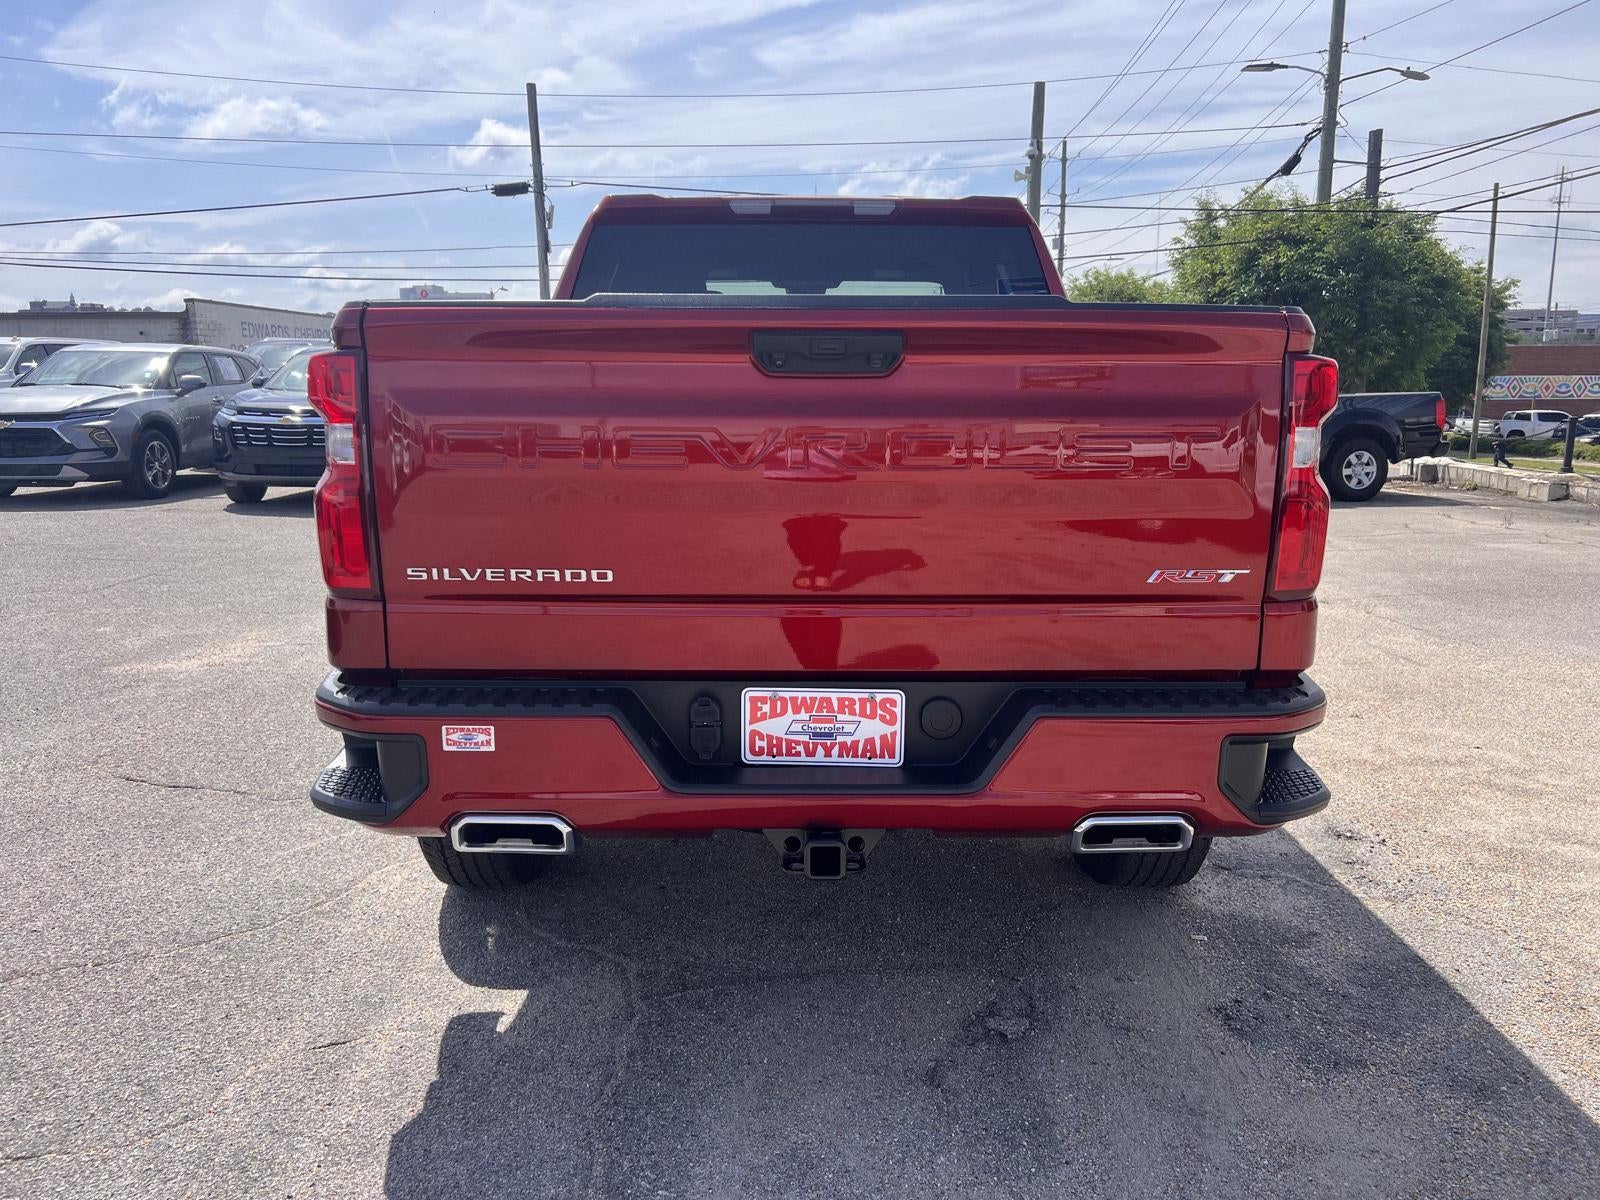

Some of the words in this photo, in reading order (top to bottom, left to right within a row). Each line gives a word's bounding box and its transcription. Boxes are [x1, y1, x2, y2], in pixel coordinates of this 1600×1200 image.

[240, 321, 290, 339] EDWARDS
[430, 423, 1223, 471] CHEVROLET
[406, 567, 614, 583] SILVERADO
[1146, 569, 1251, 583] RST
[748, 695, 898, 726] EDWARDS
[801, 723, 845, 732] Chevrolet
[748, 728, 898, 760] CHEVYMAN
